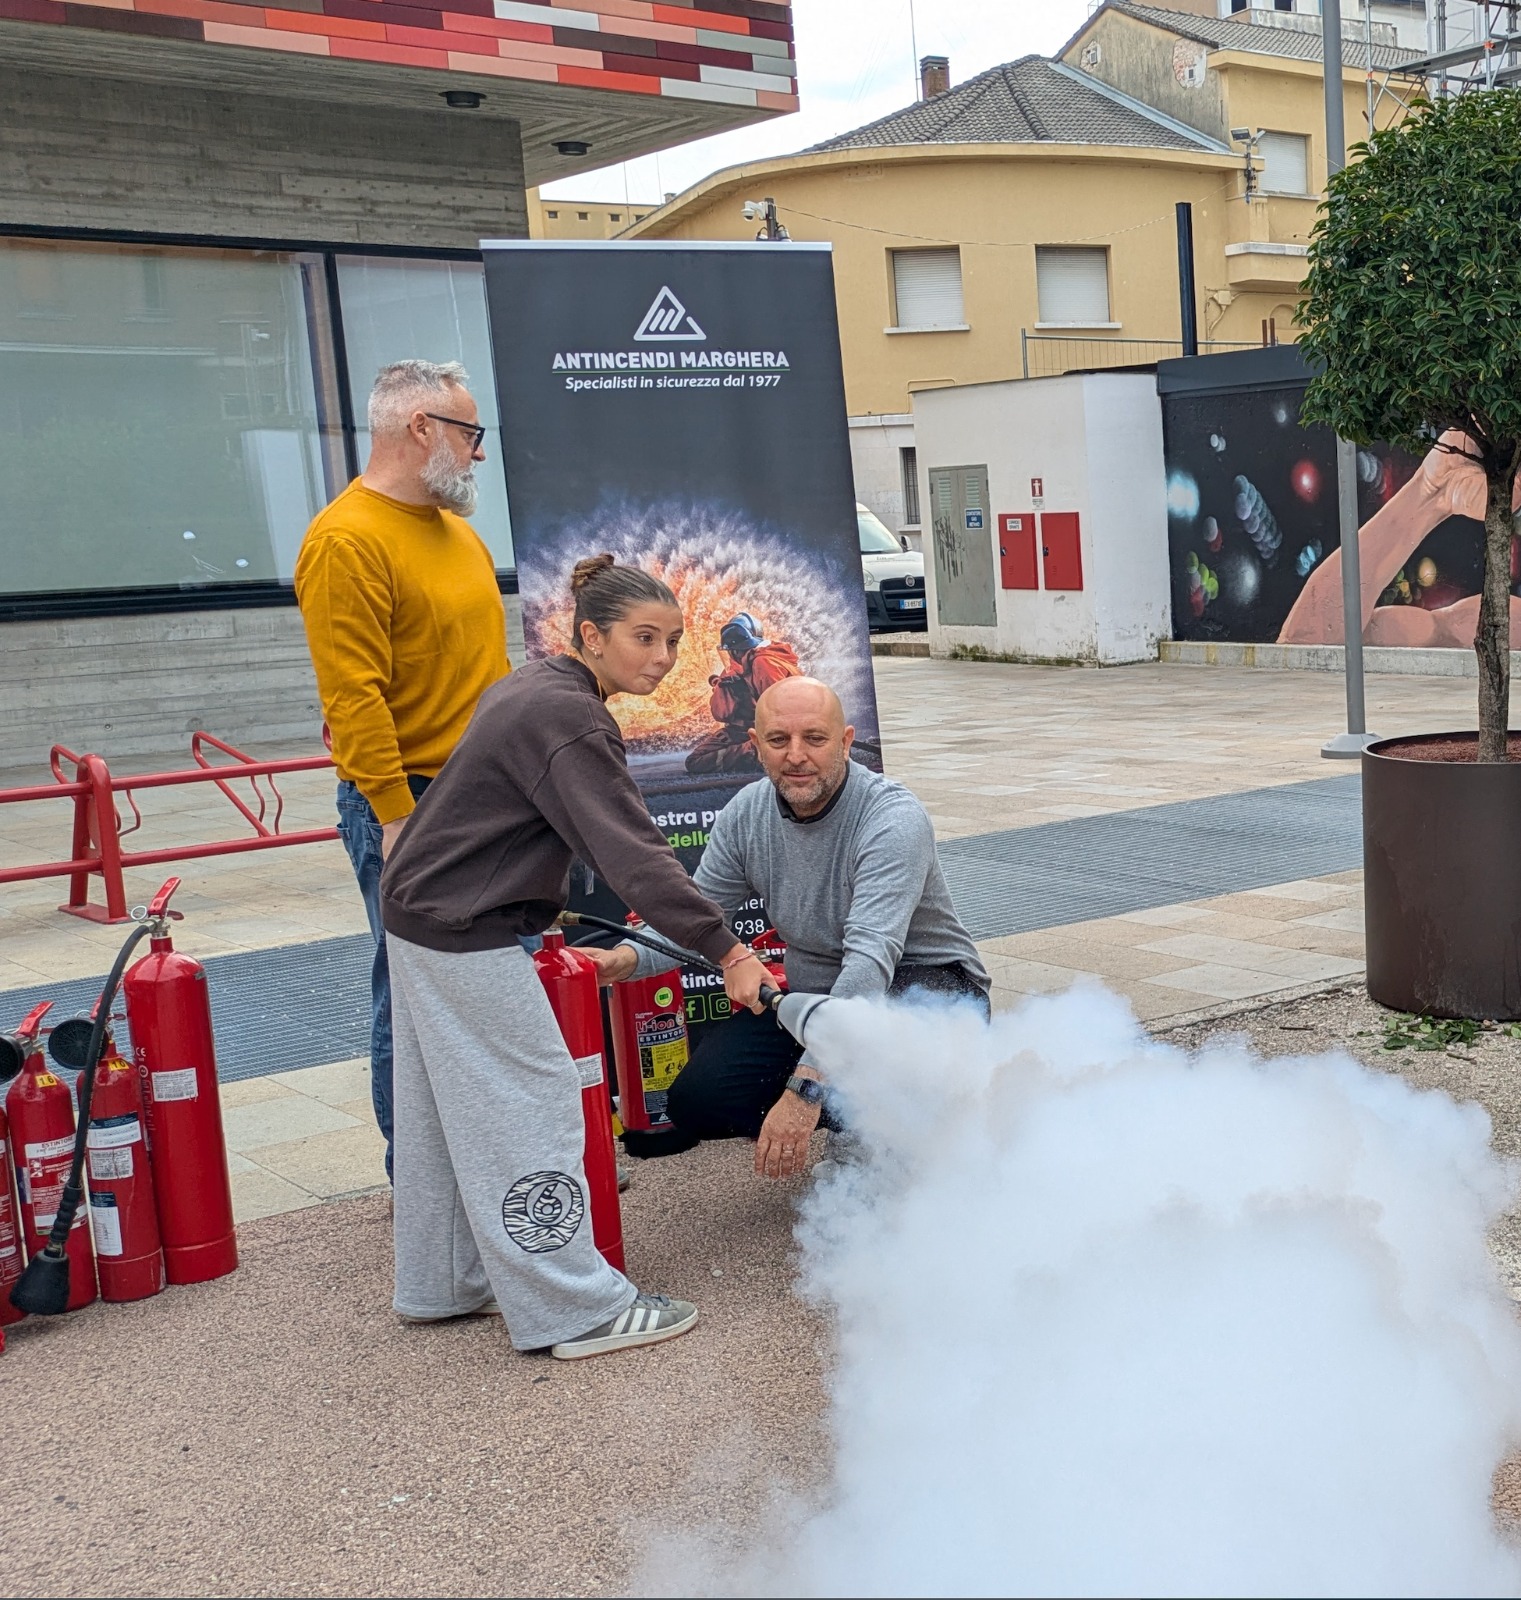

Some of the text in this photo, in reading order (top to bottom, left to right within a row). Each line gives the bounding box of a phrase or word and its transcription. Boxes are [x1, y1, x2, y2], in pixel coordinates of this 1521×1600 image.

[552, 351, 790, 369] ANTINCENDI MARGHERA
[565, 374, 781, 392] Specialisti in sicurezza dal 1977
